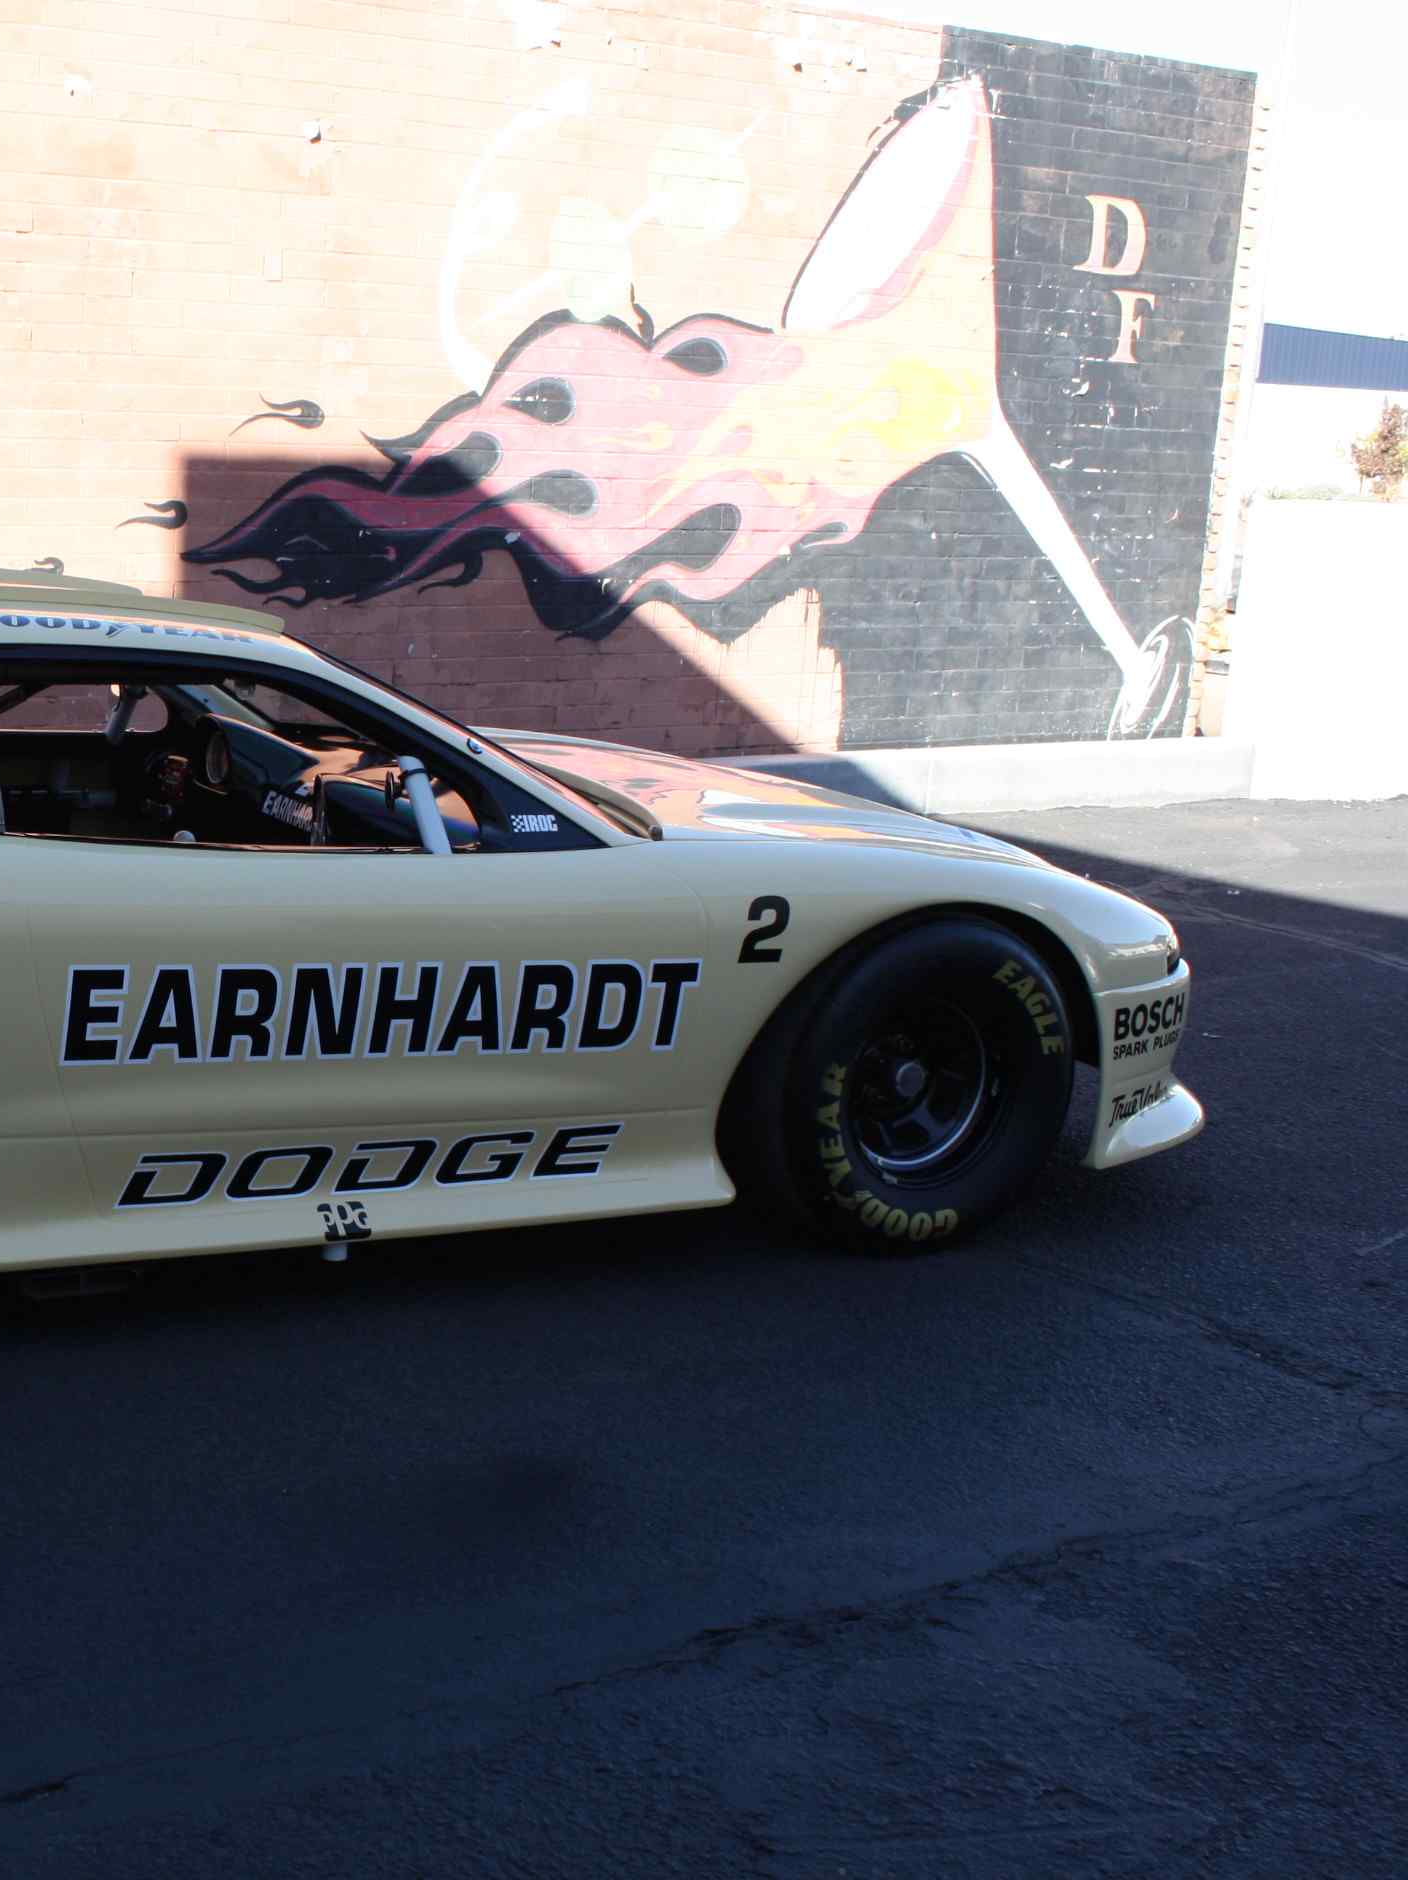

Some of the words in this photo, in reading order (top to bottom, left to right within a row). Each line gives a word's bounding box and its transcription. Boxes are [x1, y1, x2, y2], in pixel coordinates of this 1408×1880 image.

[1073, 194, 1148, 276] D
[1107, 288, 1155, 363] F
[522, 814, 559, 832] IROC
[738, 895, 790, 963] 2
[59, 958, 704, 1067] EARNHARDT
[993, 959, 1065, 1056] EAGLE
[1114, 992, 1186, 1041] BOSCH
[1113, 1039, 1149, 1060] SPARK
[113, 1121, 626, 1208] DODGE
[816, 1062, 960, 1241] GOODYEAR
